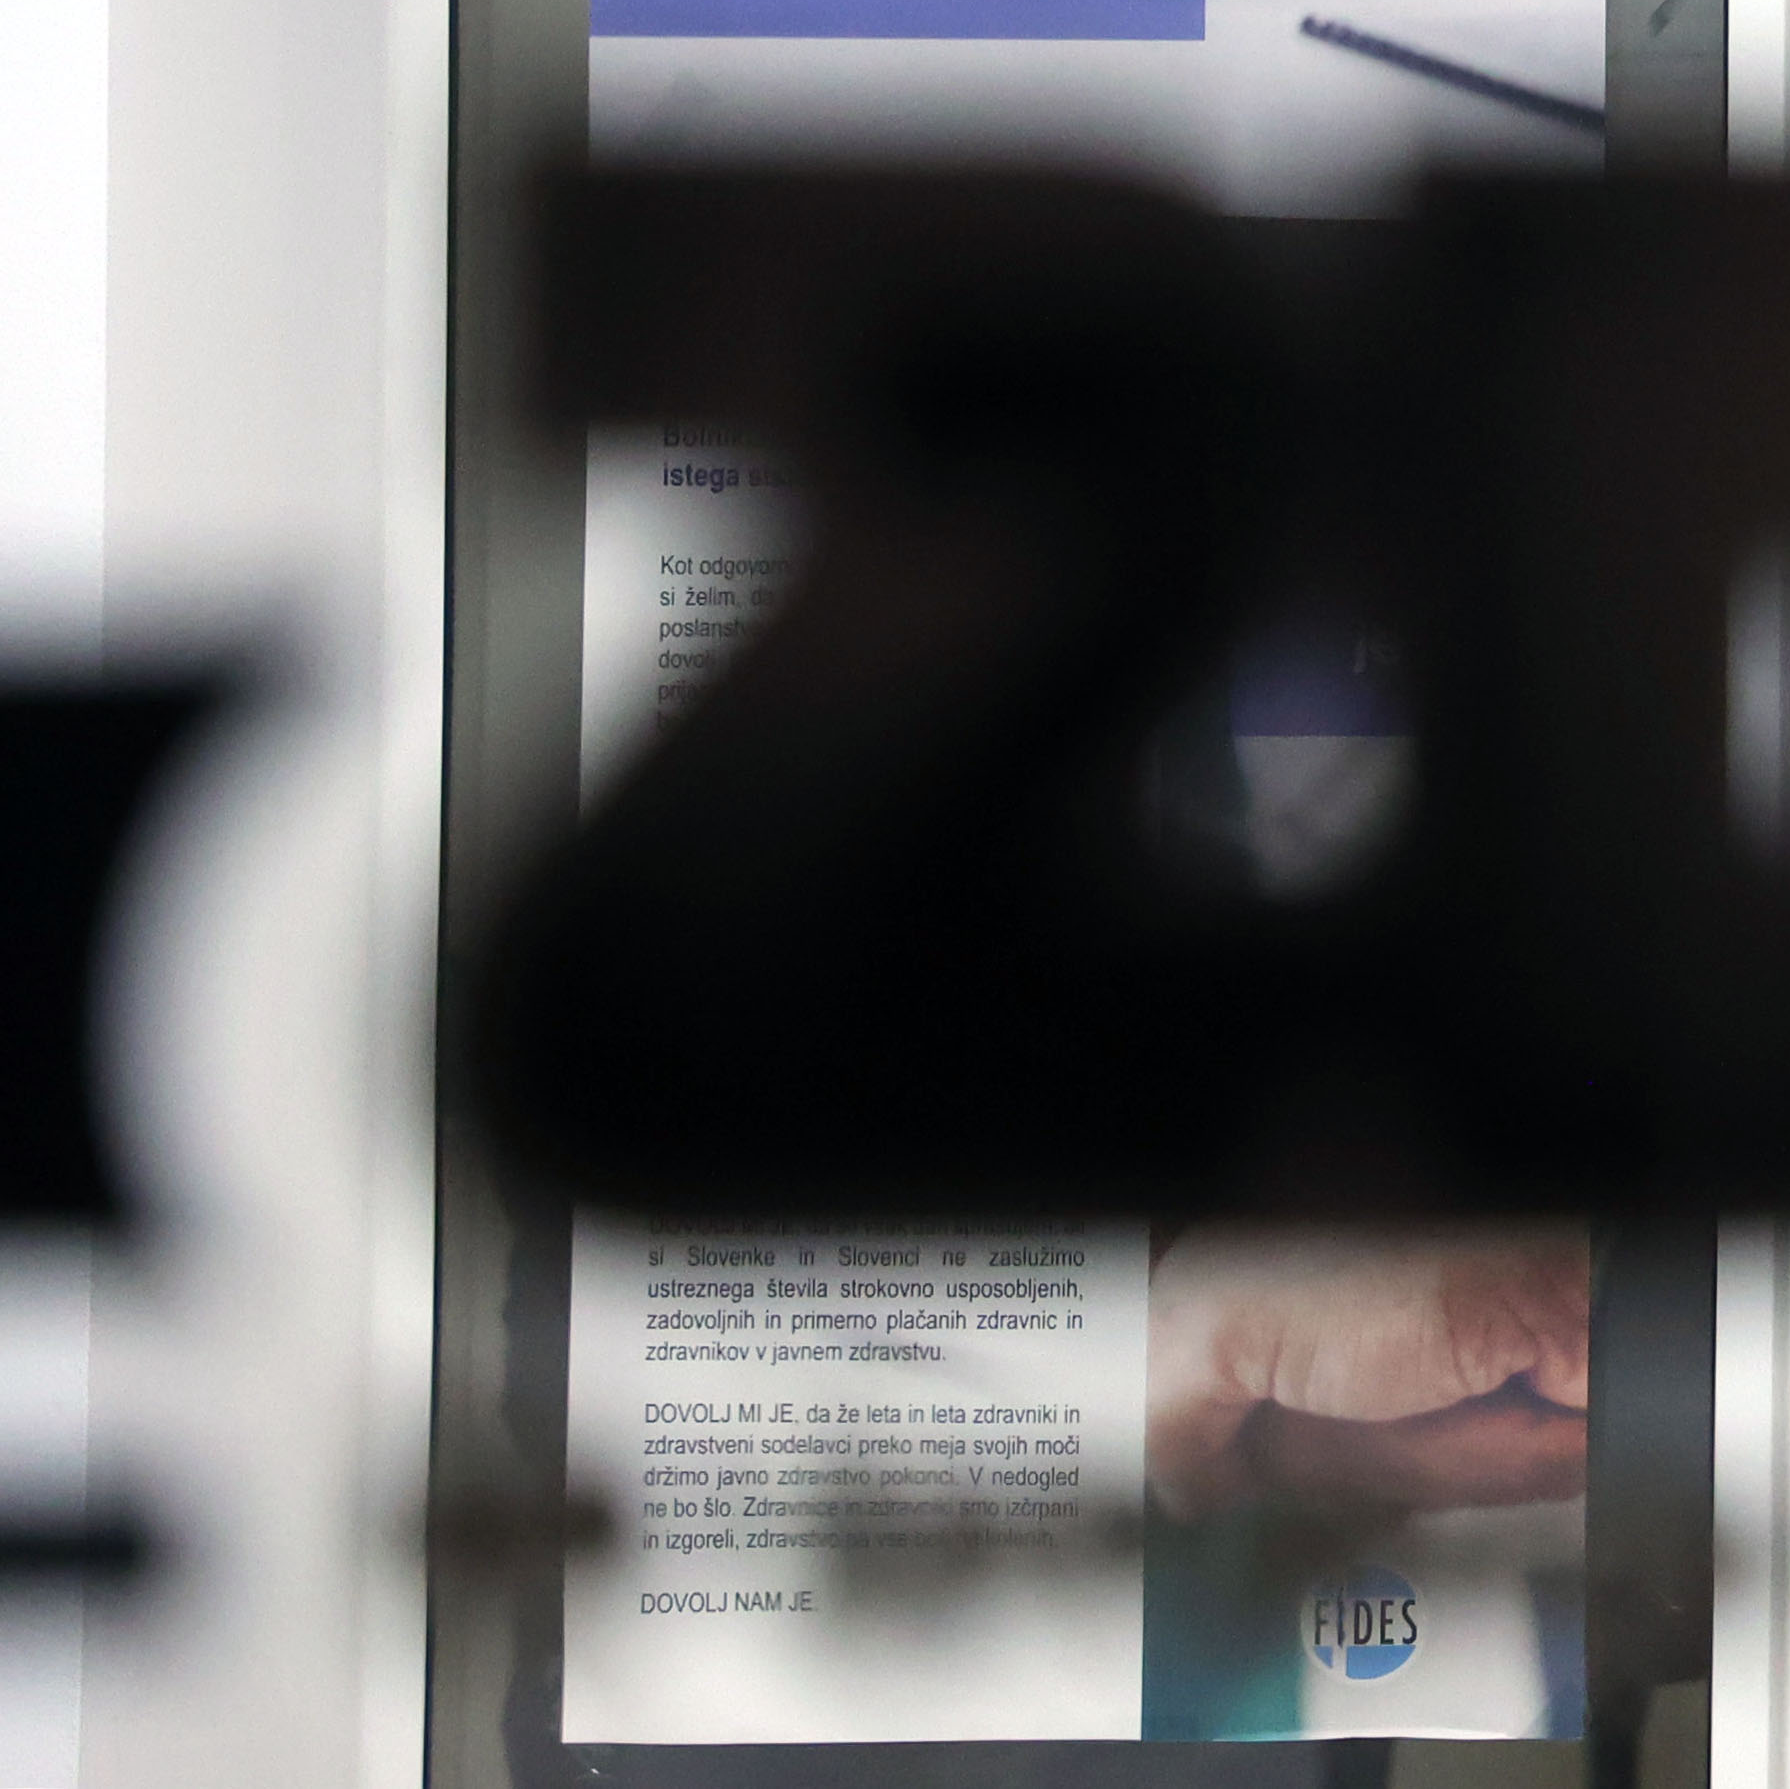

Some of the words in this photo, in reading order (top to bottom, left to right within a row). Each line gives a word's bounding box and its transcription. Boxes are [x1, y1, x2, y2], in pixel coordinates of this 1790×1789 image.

[662, 462, 740, 494] istega
[660, 555, 693, 576] Kot
[659, 588, 675, 607] si
[648, 1248, 665, 1268] si
[687, 1248, 776, 1268] Slovenke
[799, 1248, 815, 1268] in
[838, 1248, 920, 1268] Slovenci
[942, 1252, 967, 1268] ne
[989, 1248, 1086, 1268] zaslužimo
[647, 1278, 755, 1302] ustreznega
[766, 1278, 828, 1298] števila
[839, 1278, 934, 1298] strokovno
[945, 1278, 1084, 1302] usposobljenih,
[645, 1310, 756, 1334] zadovoljnih
[764, 1310, 782, 1330] in
[791, 1310, 878, 1334] primerno
[885, 1310, 967, 1334] plačanih
[975, 1310, 1058, 1330] zdravnic
[1066, 1310, 1084, 1330] in
[644, 1342, 750, 1362] zdravnikov
[755, 1346, 768, 1362] v
[770, 1342, 842, 1366] javnem
[848, 1342, 946, 1362] zdravstvu.
[644, 1404, 733, 1424] DOVOLJ
[738, 1404, 762, 1424] MI
[805, 1404, 831, 1424] da
[836, 1404, 861, 1424] že
[866, 1404, 901, 1424] leta
[908, 1404, 925, 1424] in
[930, 1404, 966, 1424] leta
[972, 1404, 1059, 1424] zdravniki
[1063, 1404, 1081, 1424] in
[643, 1435, 755, 1455] zdravstveni
[760, 1435, 852, 1455] sodelavci
[857, 1435, 913, 1459] preko
[919, 1435, 967, 1459] meja
[972, 1435, 1029, 1459] svojih
[1034, 1435, 1081, 1455] moči
[643, 1467, 709, 1487] držimo
[714, 1467, 769, 1491] javno
[776, 1467, 871, 1487] zdravstvo
[968, 1467, 984, 1487] V
[990, 1467, 1080, 1491] nedogled
[642, 1502, 668, 1518] ne
[673, 1498, 699, 1518] bo
[703, 1498, 735, 1518] šlo.
[1004, 1498, 1080, 1522] izčrpani
[642, 1530, 660, 1550] in
[664, 1530, 741, 1554] izgoreli,
[640, 1593, 729, 1613] DOVOLJ
[734, 1593, 783, 1613] NAM
[1314, 1587, 1418, 1647] FIDES
